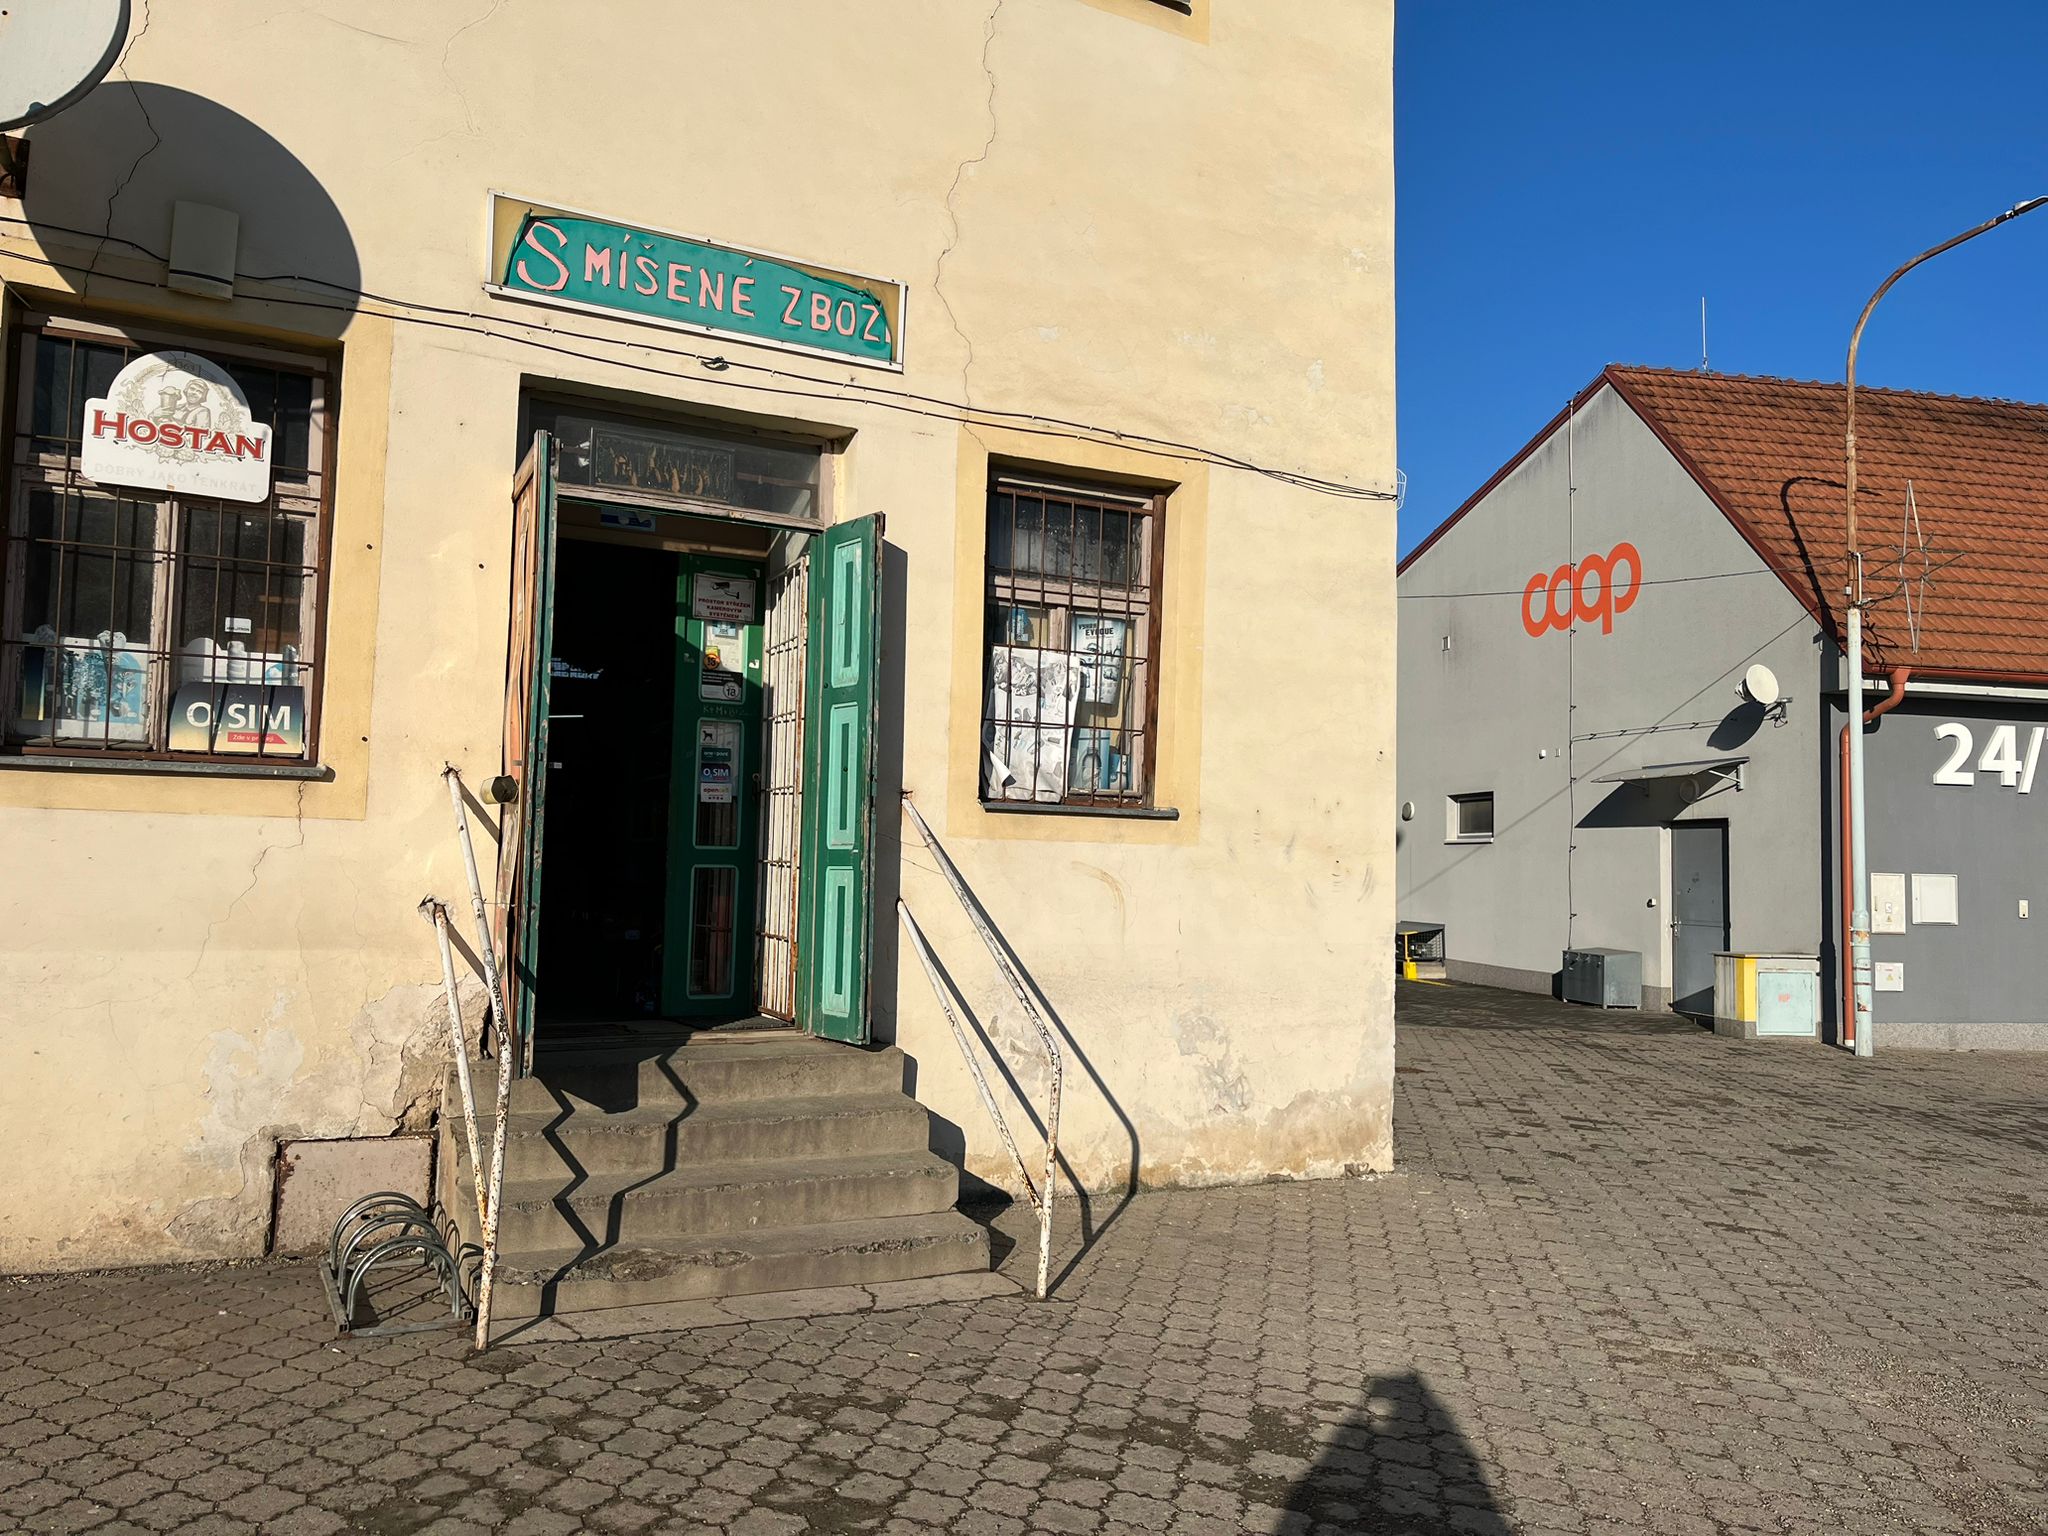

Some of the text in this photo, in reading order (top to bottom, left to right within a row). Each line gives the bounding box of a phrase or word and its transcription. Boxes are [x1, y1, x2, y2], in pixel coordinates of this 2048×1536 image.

[516, 220, 757, 319] SMÍŠENÉ
[91, 408, 266, 462] HOSTAN
[150, 469, 187, 484] JAKO
[1521, 542, 1642, 638] coop
[227, 703, 291, 731] SIM
[251, 735, 275, 743] preji
[1932, 722, 2048, 794] 24/
[713, 768, 729, 777] SIM
